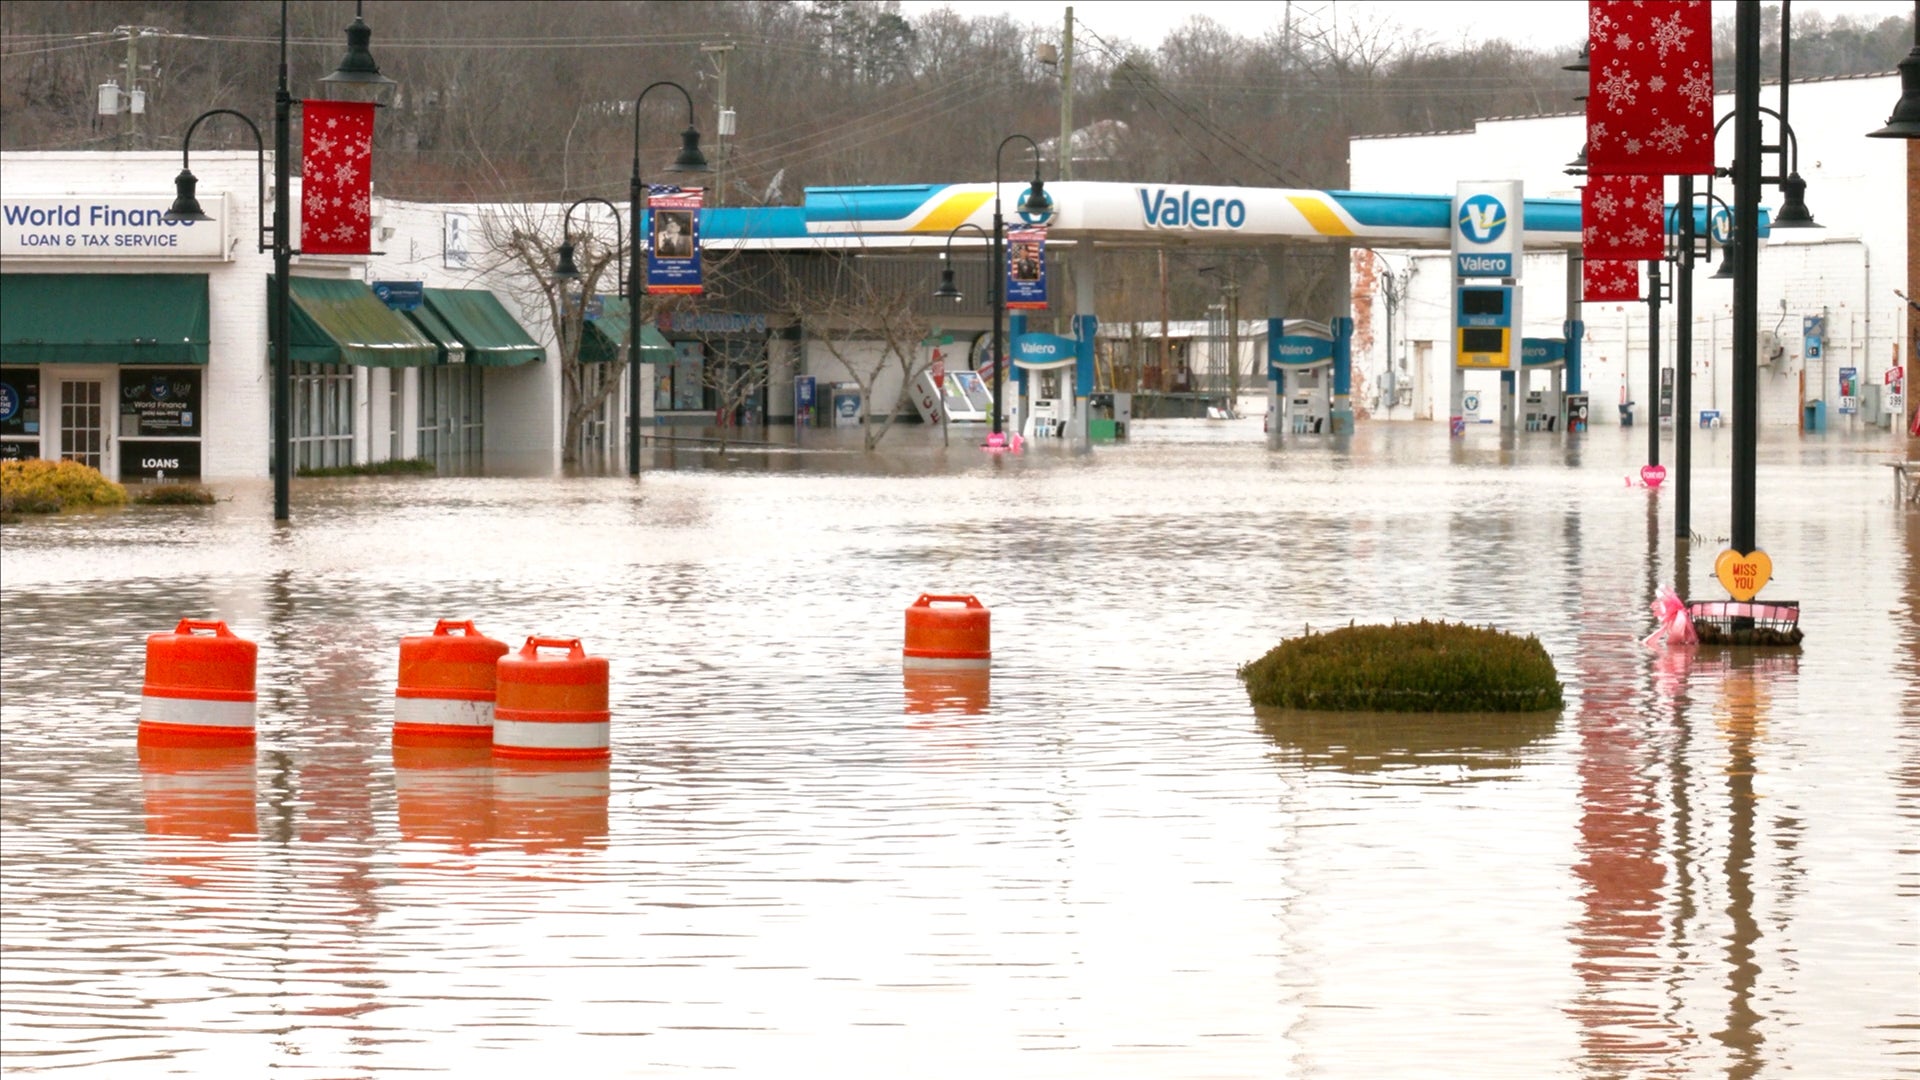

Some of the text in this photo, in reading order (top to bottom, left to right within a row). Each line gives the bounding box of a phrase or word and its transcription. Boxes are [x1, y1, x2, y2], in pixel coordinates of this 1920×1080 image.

[1141, 189, 1245, 228] Valero
[4, 205, 195, 226] World Finan
[21, 234, 178, 246] LOAN & TAX SERVICE
[1460, 257, 1506, 271] Valero
[1021, 343, 1056, 354] Valero
[1279, 345, 1313, 355] Valero
[142, 458, 179, 469] LOANS
[1733, 563, 1757, 576] MISS
[1734, 577, 1754, 590] YOU
